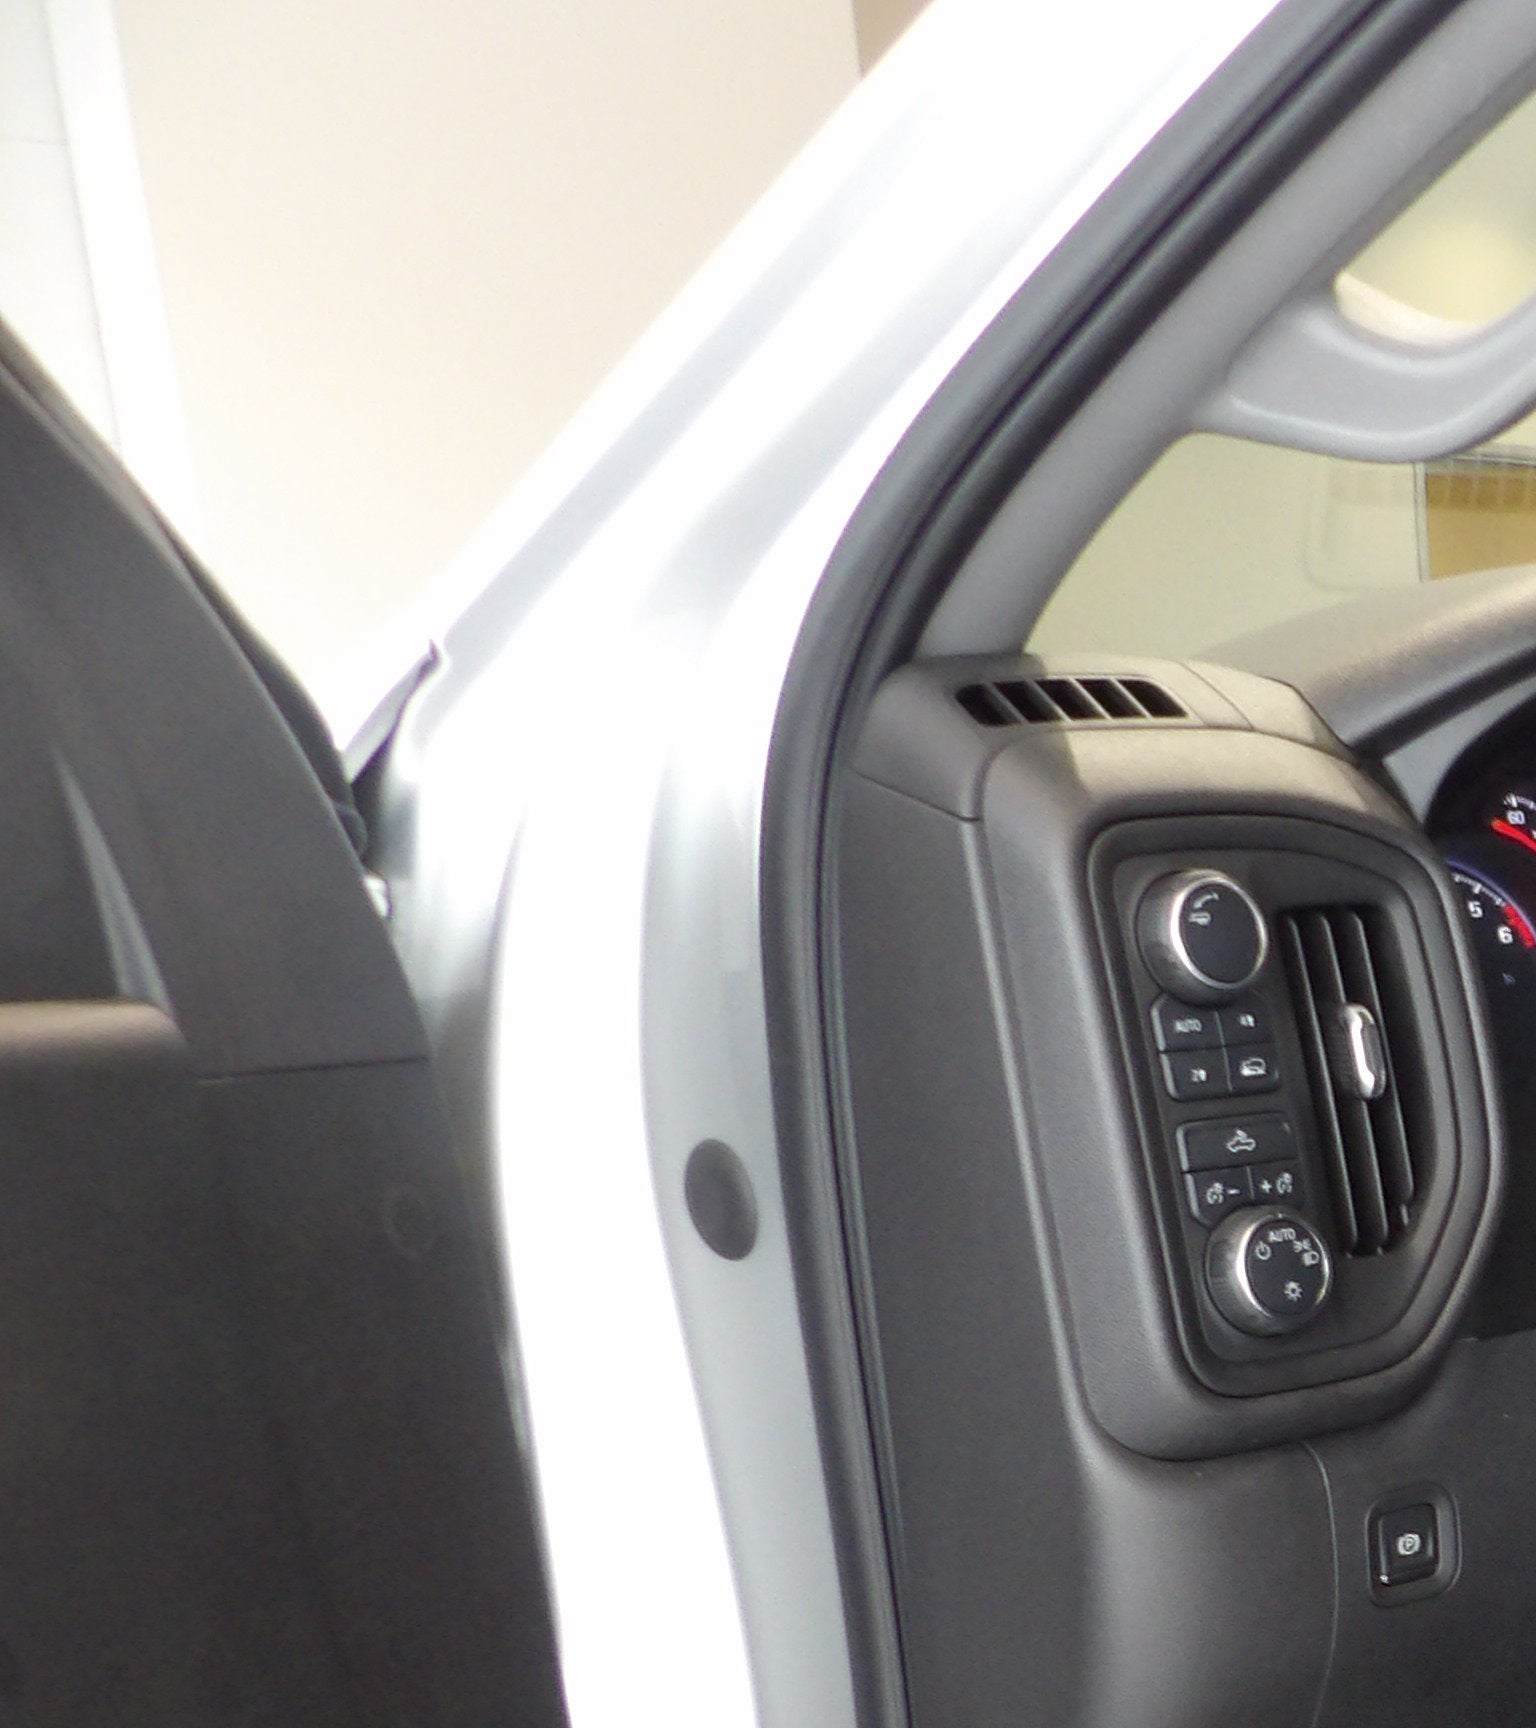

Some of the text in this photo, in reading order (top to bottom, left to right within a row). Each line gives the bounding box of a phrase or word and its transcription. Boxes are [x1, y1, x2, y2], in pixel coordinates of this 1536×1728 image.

[1468, 901, 1483, 918] 5
[1498, 926, 1513, 944] 6
[1174, 1018, 1202, 1034] AUTO
[1268, 1227, 1297, 1244] AUTO
